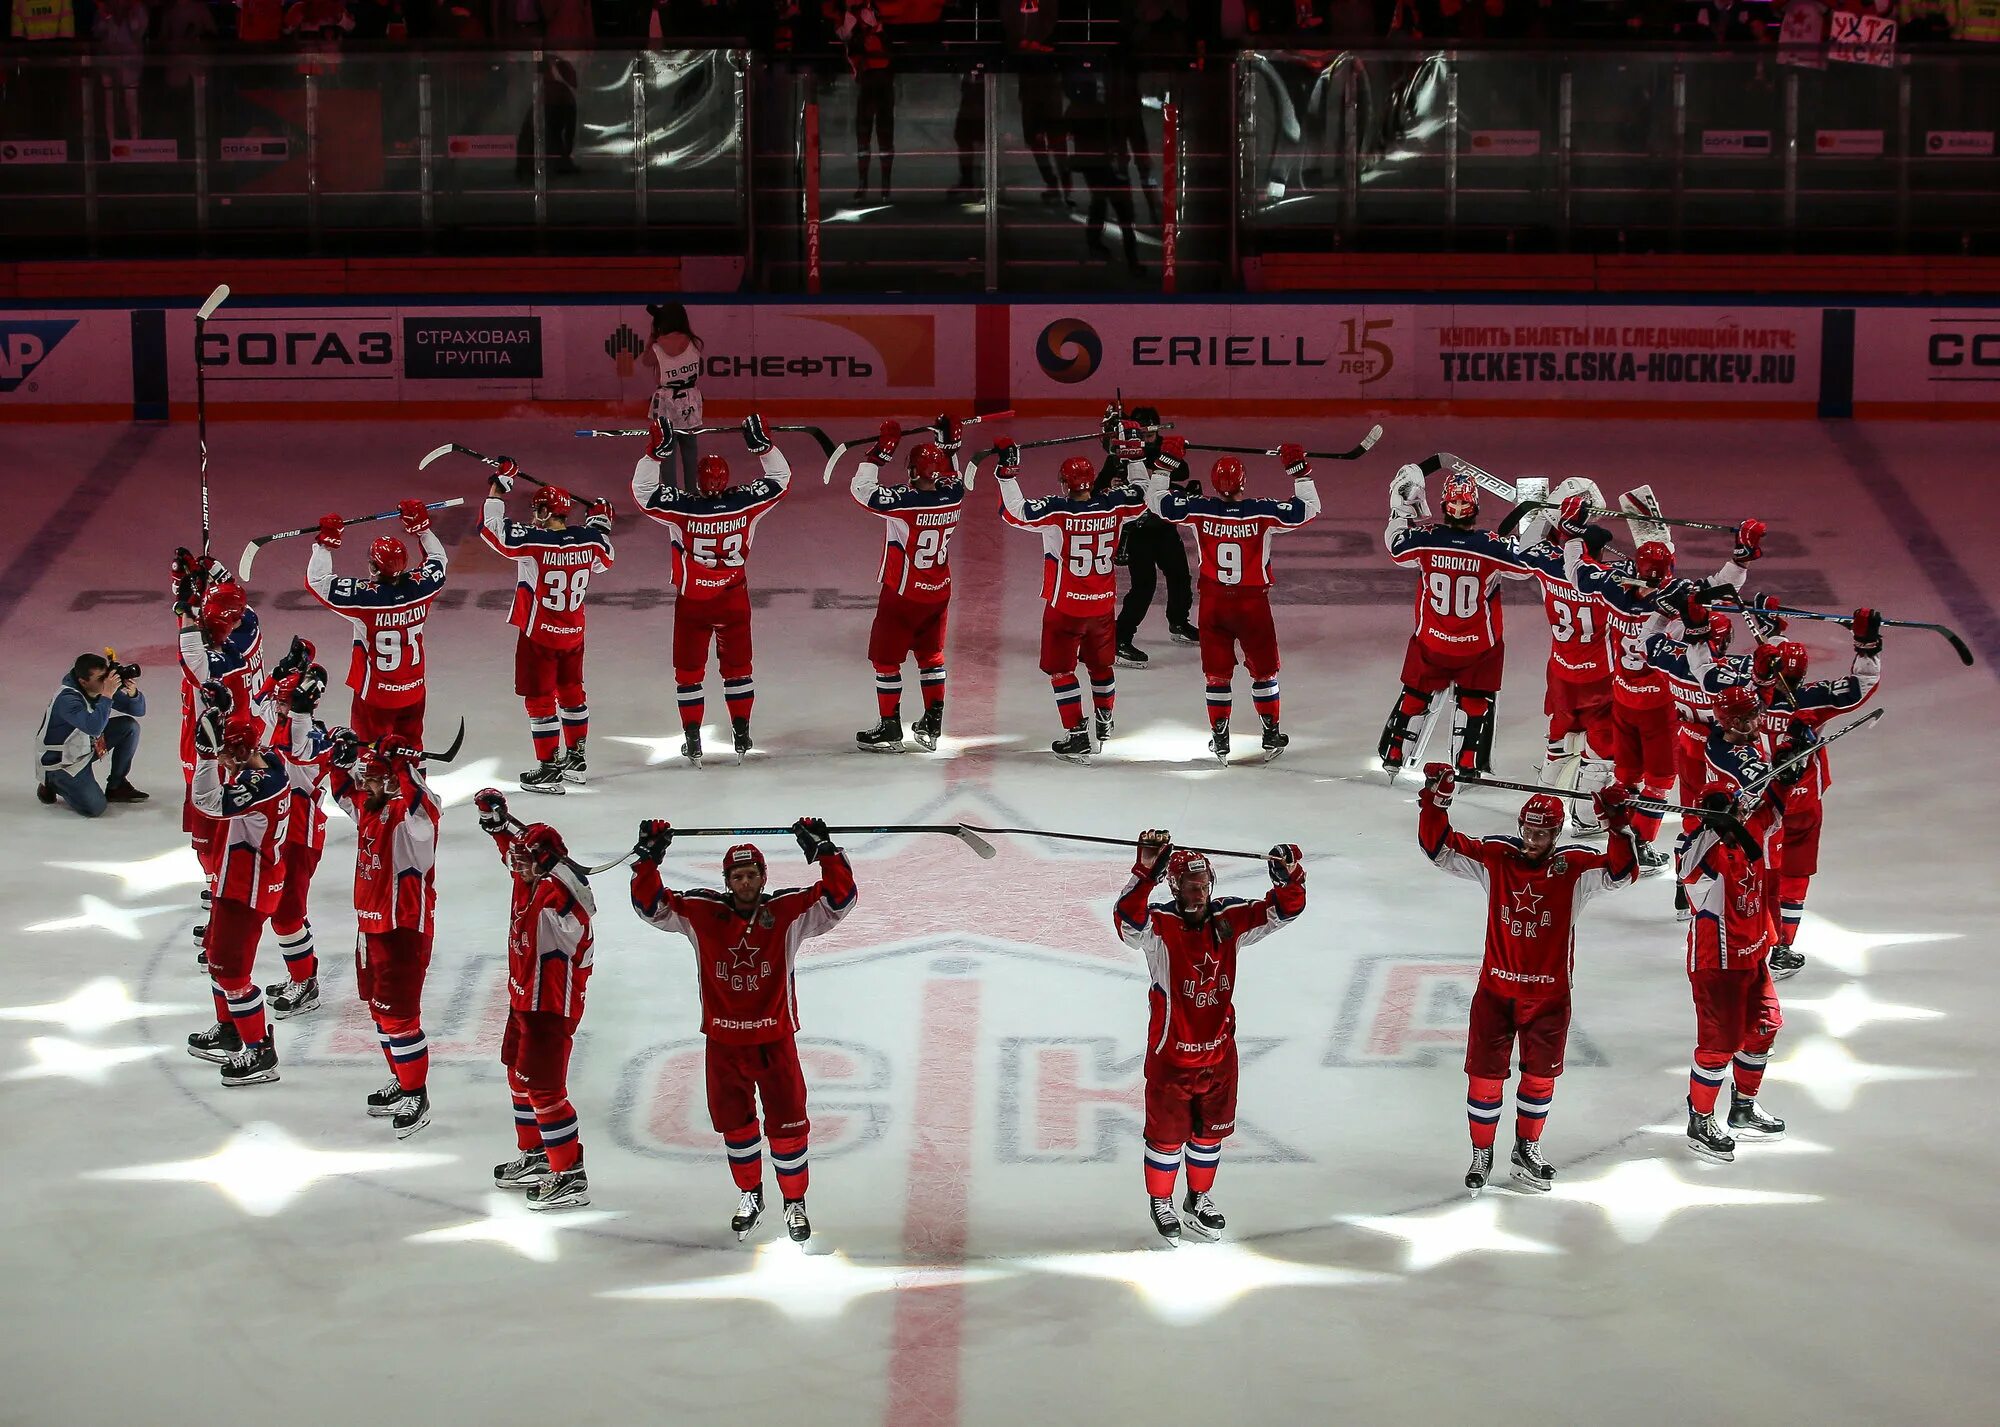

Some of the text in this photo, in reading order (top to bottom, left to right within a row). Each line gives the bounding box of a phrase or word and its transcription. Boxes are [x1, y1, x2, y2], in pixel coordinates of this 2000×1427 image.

[1835, 17, 1895, 43] УХТА
[23, 148, 64, 156] ERIELL
[195, 331, 393, 366] СОГАЗ
[416, 329, 531, 345] СТРАХОВАЯ
[1132, 336, 1327, 366] ERIELL
[1439, 325, 1796, 349] КУПИТЬ БИЛЕТЫ НА СЛЕДУЮЩИЙ МАТЧ:
[435, 350, 512, 365] ГРУППА
[1338, 318, 1394, 385] 15
[698, 356, 873, 378] СНЕФТЬ
[1338, 359, 1376, 374] лет
[1439, 352, 1796, 383] TICKETS.CSKA-HOCKEY.RU
[1451, 461, 1512, 496] BAUER
[272, 529, 301, 541] BAUER
[687, 515, 747, 535] MARCHENKO
[1202, 521, 1259, 539] SLEPYSHEV
[692, 533, 745, 569] 53
[1069, 532, 1115, 577] 55
[1217, 542, 1242, 585] 9
[1431, 554, 1480, 573] SOROKIN
[541, 569, 590, 612] 38
[1429, 572, 1480, 619] 90
[1428, 627, 1479, 643] РОСНЕФТЬ
[1552, 600, 1595, 643] 31
[376, 624, 424, 671] 97
[397, 747, 422, 757] CCM
[1501, 904, 1552, 938] ЦСКА
[716, 961, 771, 991] ЦСКА
[1490, 967, 1555, 984] РОСНЕФТЬ
[1182, 974, 1230, 1008] ЦСКА
[713, 1017, 777, 1029] РОСНЕФТЬ
